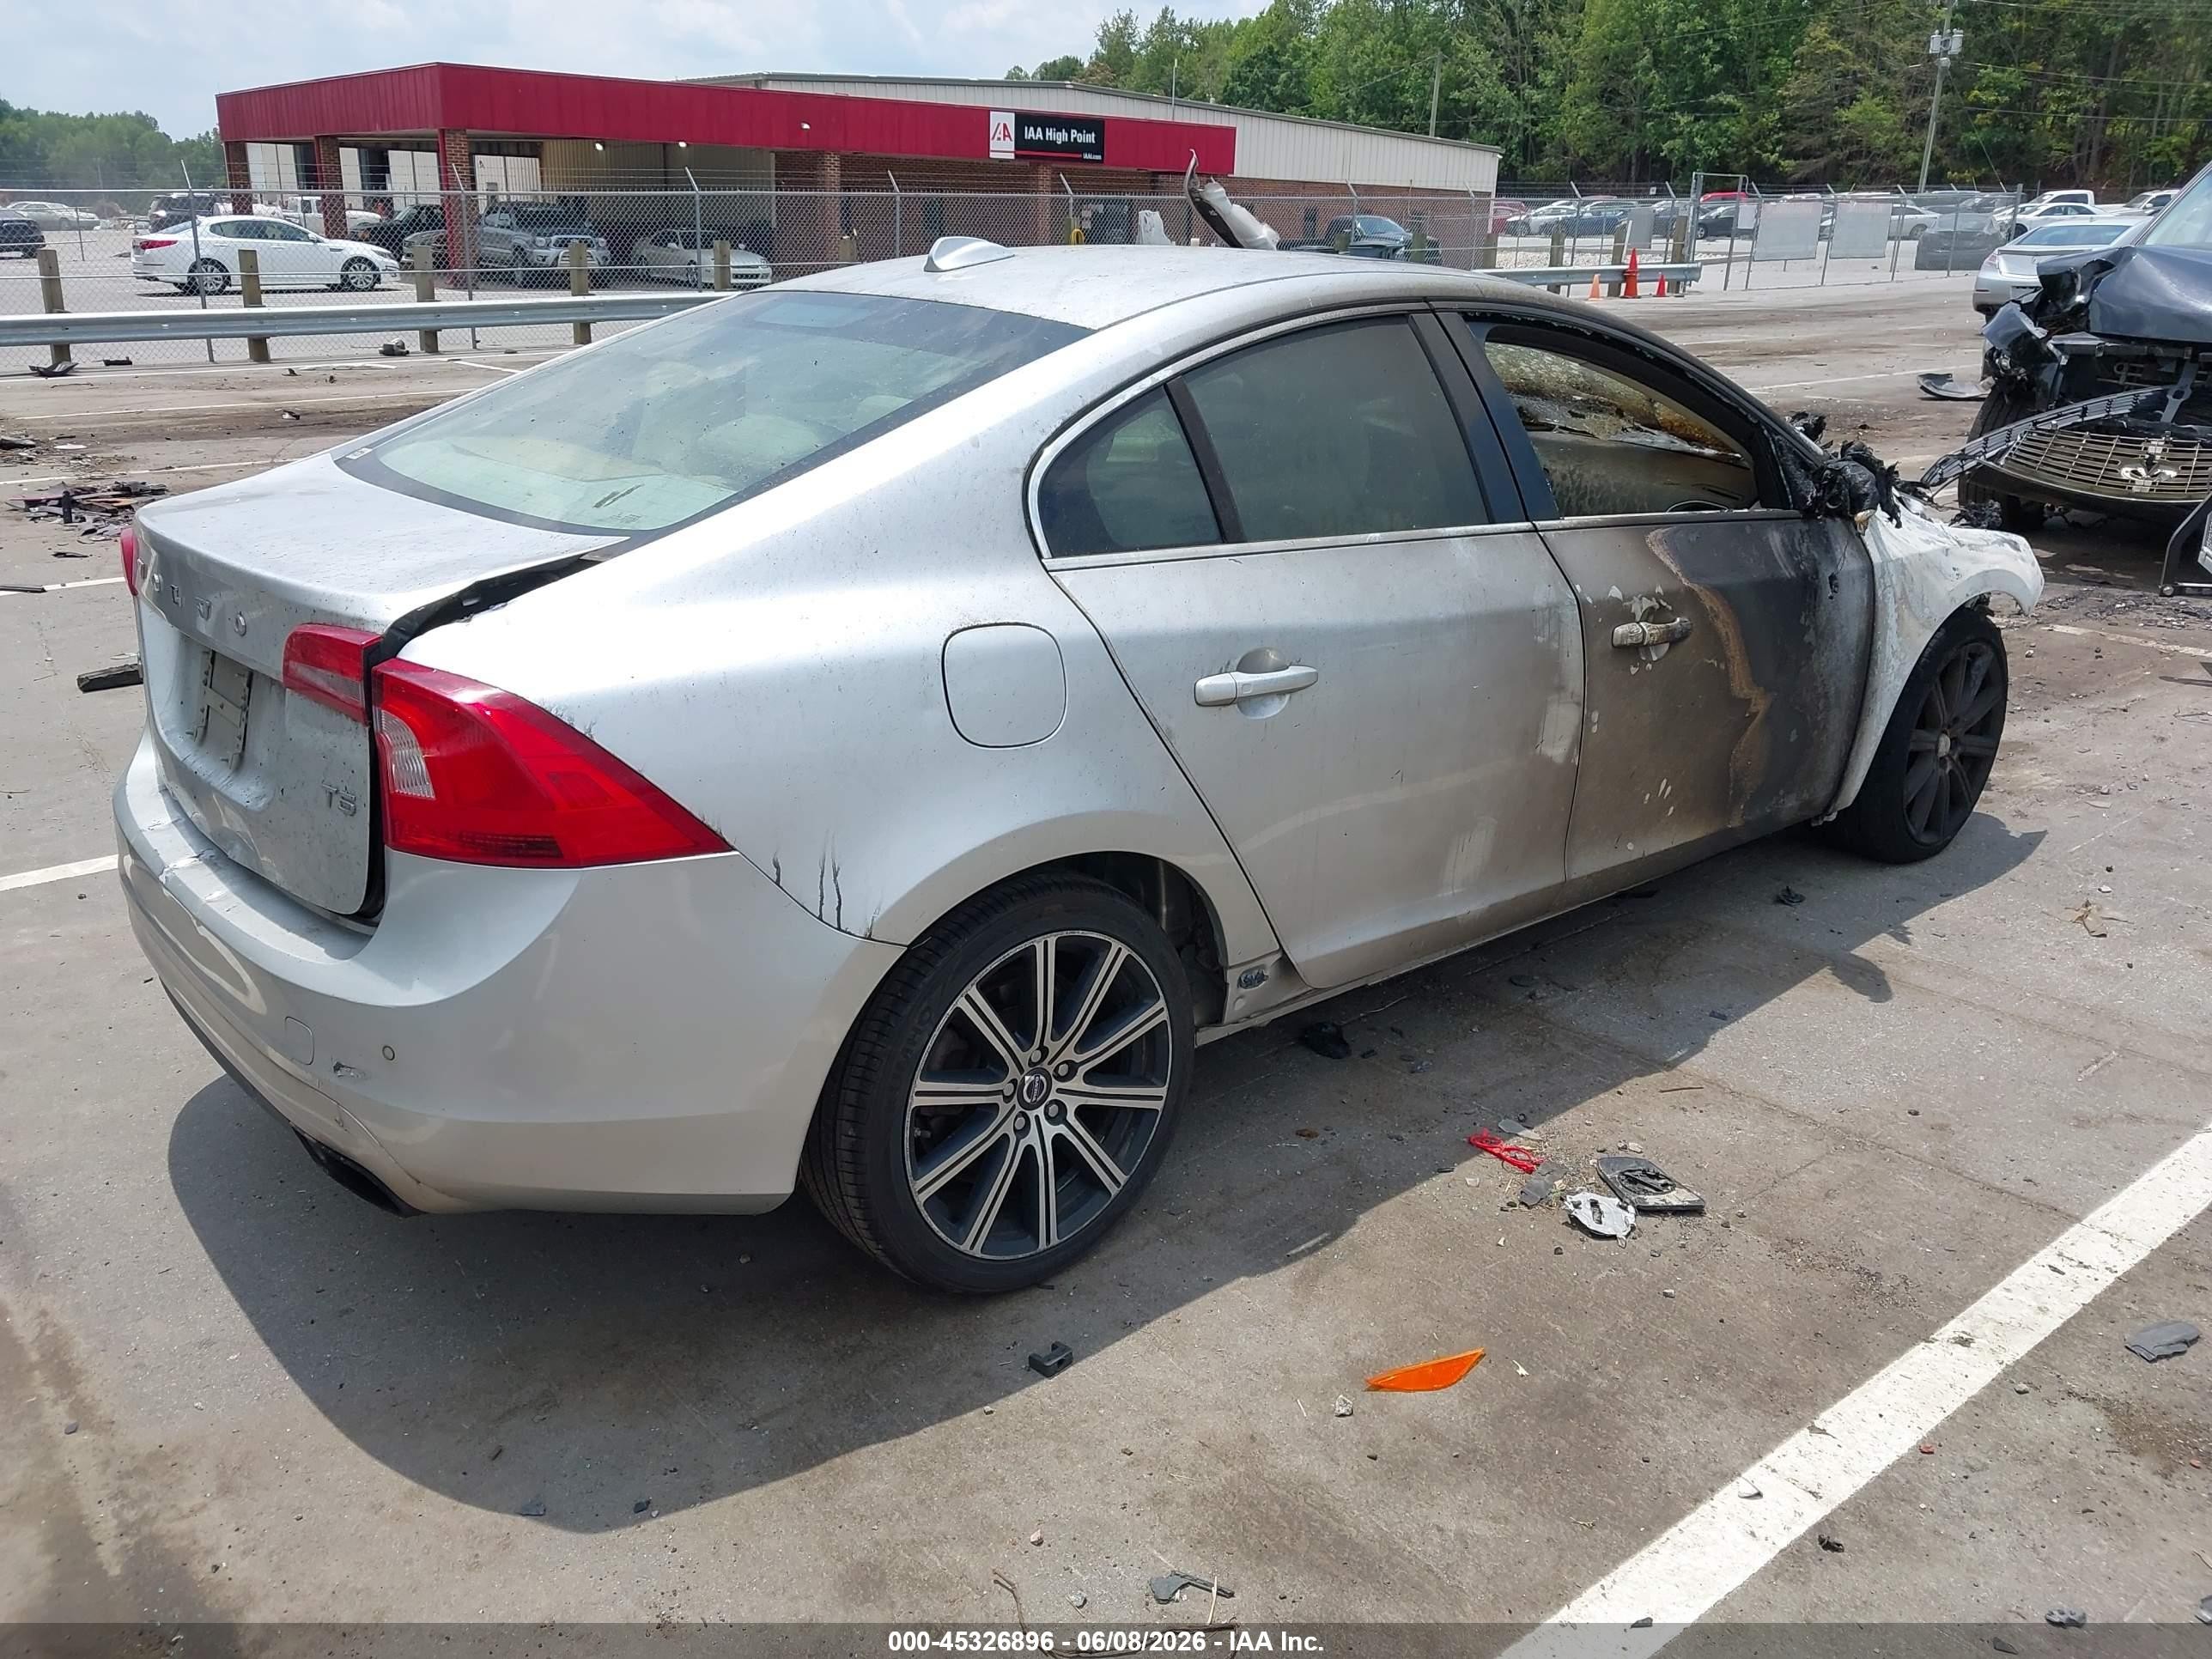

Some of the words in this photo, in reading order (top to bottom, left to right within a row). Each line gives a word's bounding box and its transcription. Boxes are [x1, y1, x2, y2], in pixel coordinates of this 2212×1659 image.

[1024, 125, 1043, 141] IAA
[1045, 126, 1068, 145] High
[1070, 128, 1096, 144] Point
[321, 783, 356, 817] T5
